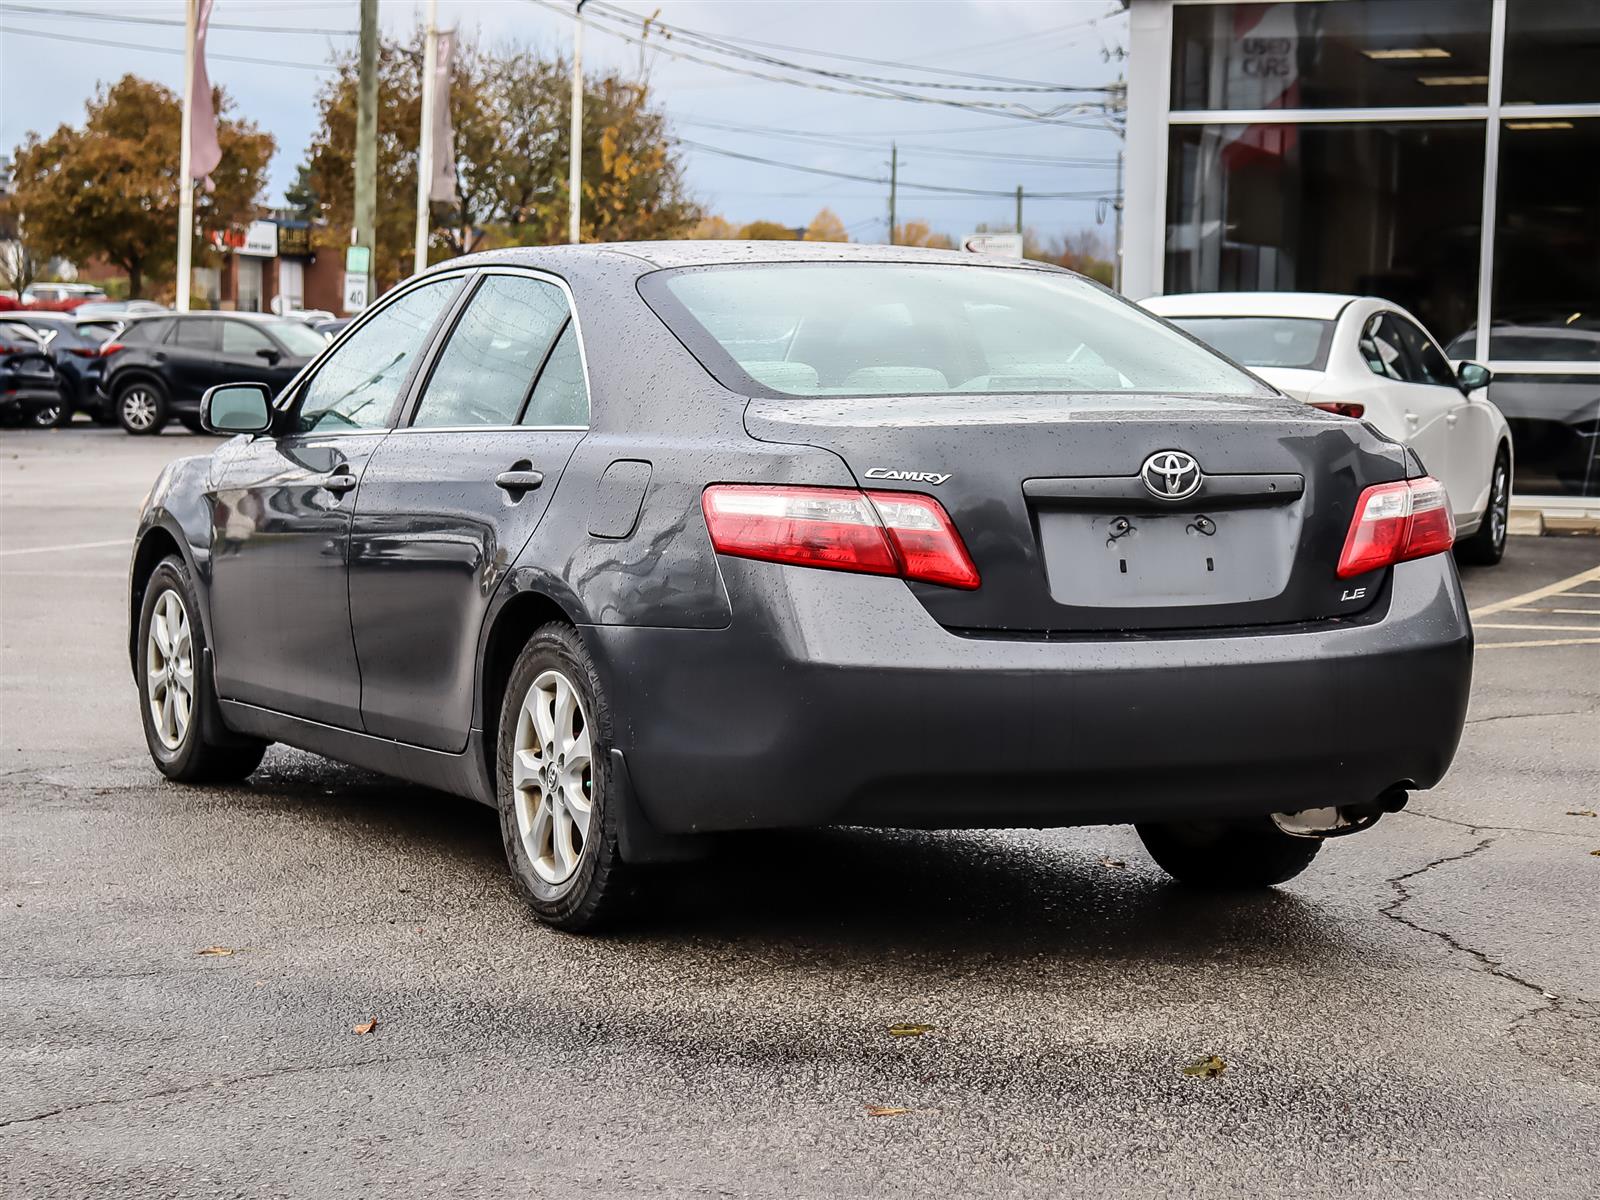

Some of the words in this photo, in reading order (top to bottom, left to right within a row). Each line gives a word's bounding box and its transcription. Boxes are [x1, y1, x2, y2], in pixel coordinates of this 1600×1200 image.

[1243, 38, 1290, 54] USED
[1242, 58, 1290, 77] CARS
[350, 290, 364, 305] 40
[864, 467, 952, 485] CAMRY
[1340, 587, 1367, 601] LE
